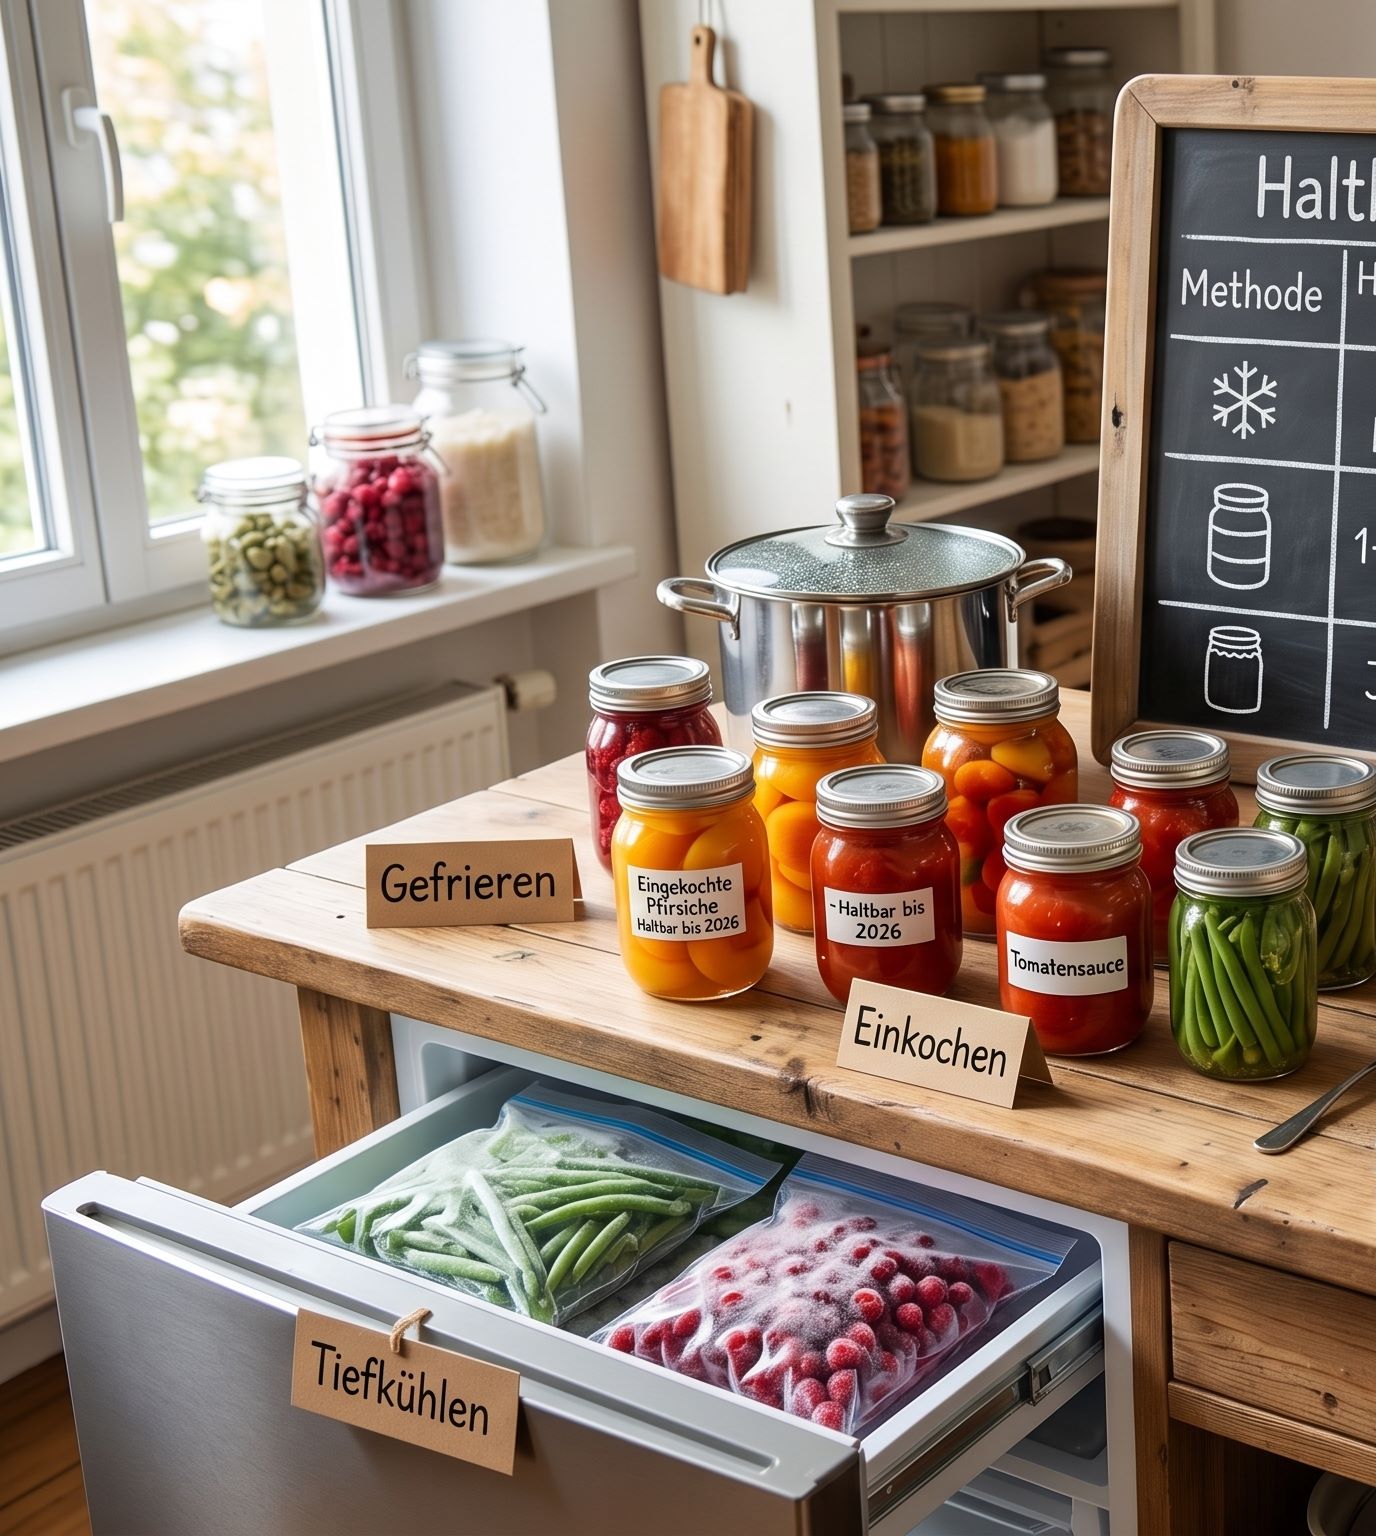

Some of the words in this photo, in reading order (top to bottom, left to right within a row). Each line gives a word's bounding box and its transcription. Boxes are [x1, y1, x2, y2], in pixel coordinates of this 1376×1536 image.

[1180, 267, 1323, 313] Methode
[380, 861, 556, 904] Gefrieren
[637, 875, 732, 899] Eingekochte
[646, 897, 719, 916] Pfirsiche
[902, 899, 926, 917] bis
[637, 917, 679, 935] Haltbar
[682, 919, 702, 935] bis
[704, 914, 740, 933] 2026
[855, 922, 902, 940] 2026
[1010, 948, 1124, 977] Tomatensauce
[854, 1005, 1007, 1078] Einkochen
[310, 1340, 489, 1436] Tiefkühlen
